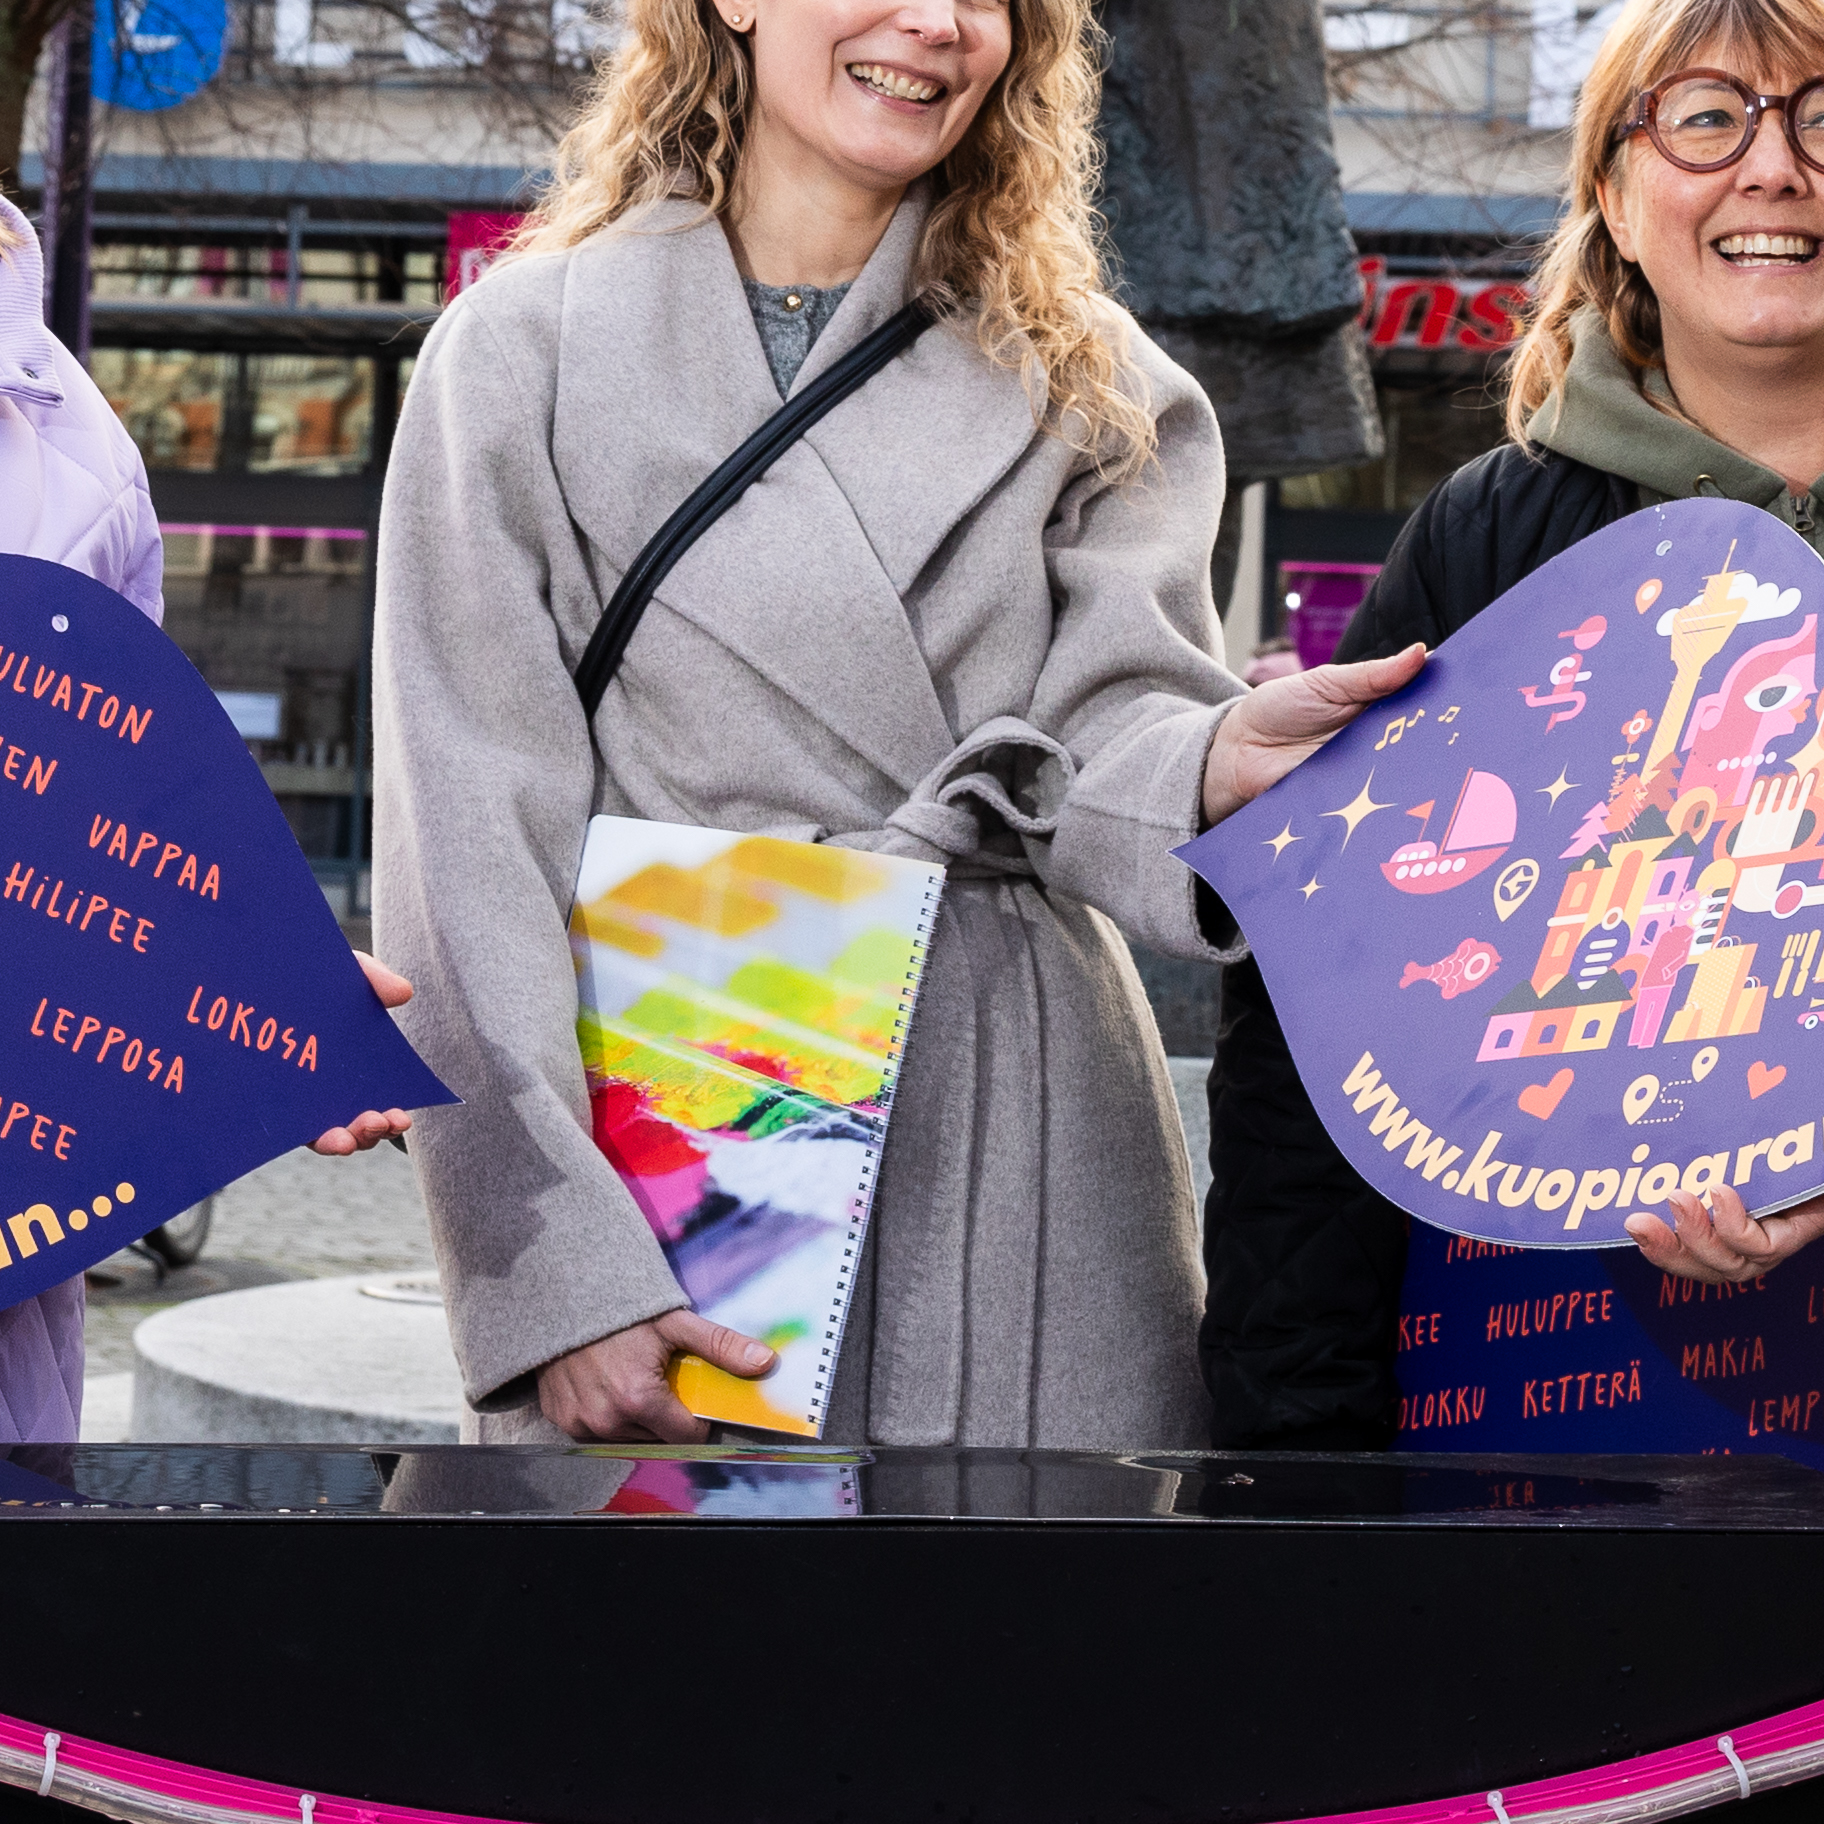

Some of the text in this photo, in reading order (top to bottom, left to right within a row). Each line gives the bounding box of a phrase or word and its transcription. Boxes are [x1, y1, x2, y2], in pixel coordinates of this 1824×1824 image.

[88, 814, 220, 900] VAPPAA
[3, 862, 155, 953] HiLiPEE
[30, 998, 184, 1093] LEPPOSA
[186, 985, 317, 1072] LOKOSA
[1397, 1313, 1442, 1352] KEE
[1486, 1289, 1614, 1343] HULUPPEE
[1682, 1336, 1765, 1380] MAKiA
[1396, 1386, 1486, 1431] OLOKKU
[1522, 1360, 1642, 1419] KETTERÄ
